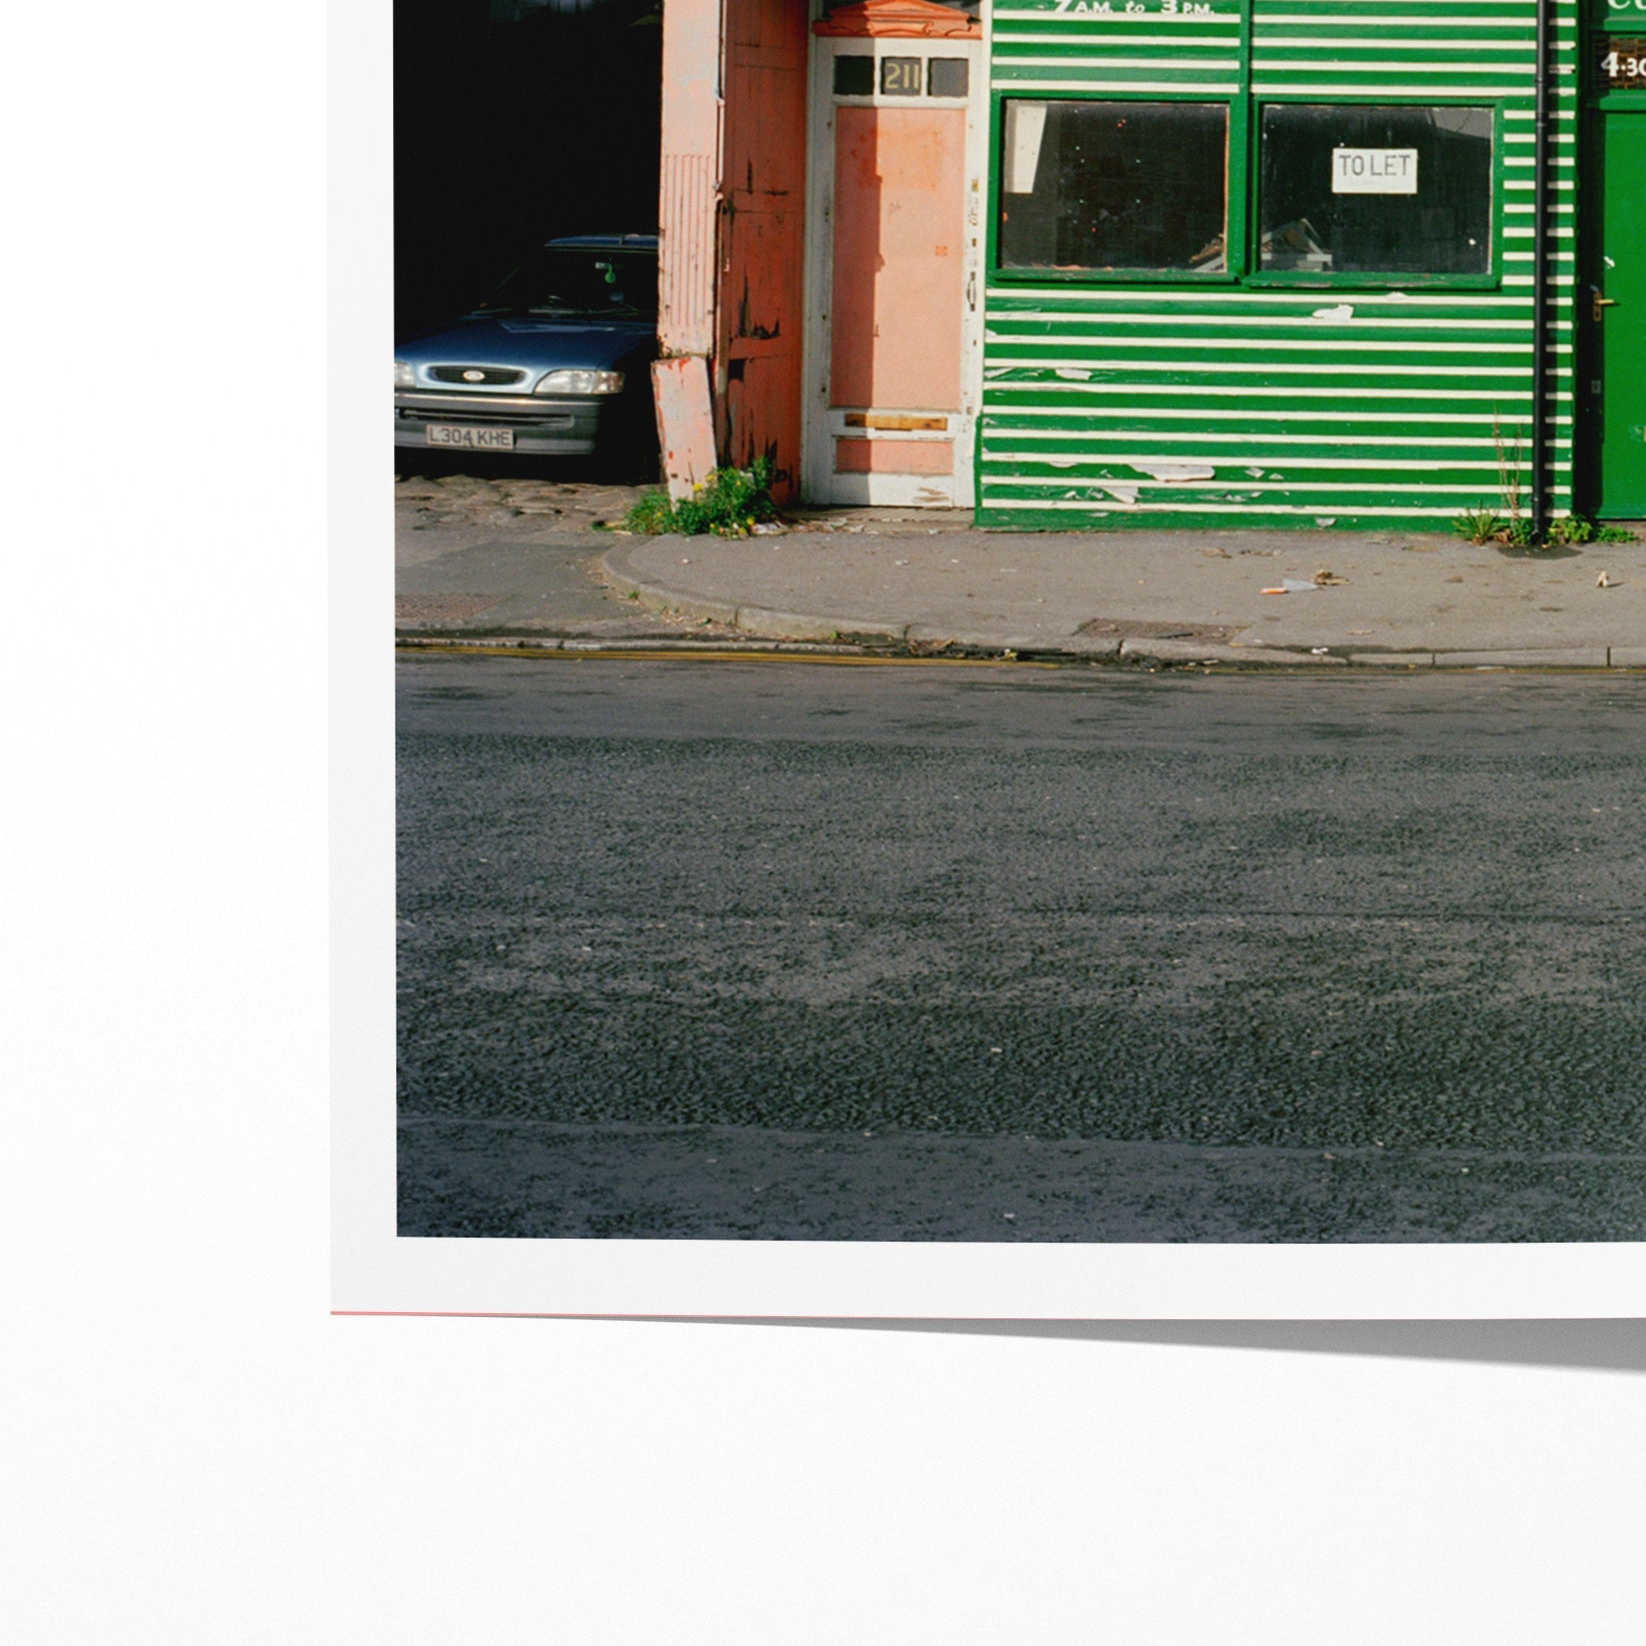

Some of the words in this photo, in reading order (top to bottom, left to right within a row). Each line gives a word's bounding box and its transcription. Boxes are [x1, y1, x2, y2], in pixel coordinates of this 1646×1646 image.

[1125, 0, 1145, 14] to
[885, 63, 921, 89] 211
[1339, 155, 1364, 176] TO
[1371, 155, 1411, 176] LET
[429, 427, 473, 448] L304
[477, 430, 511, 446] KHE
